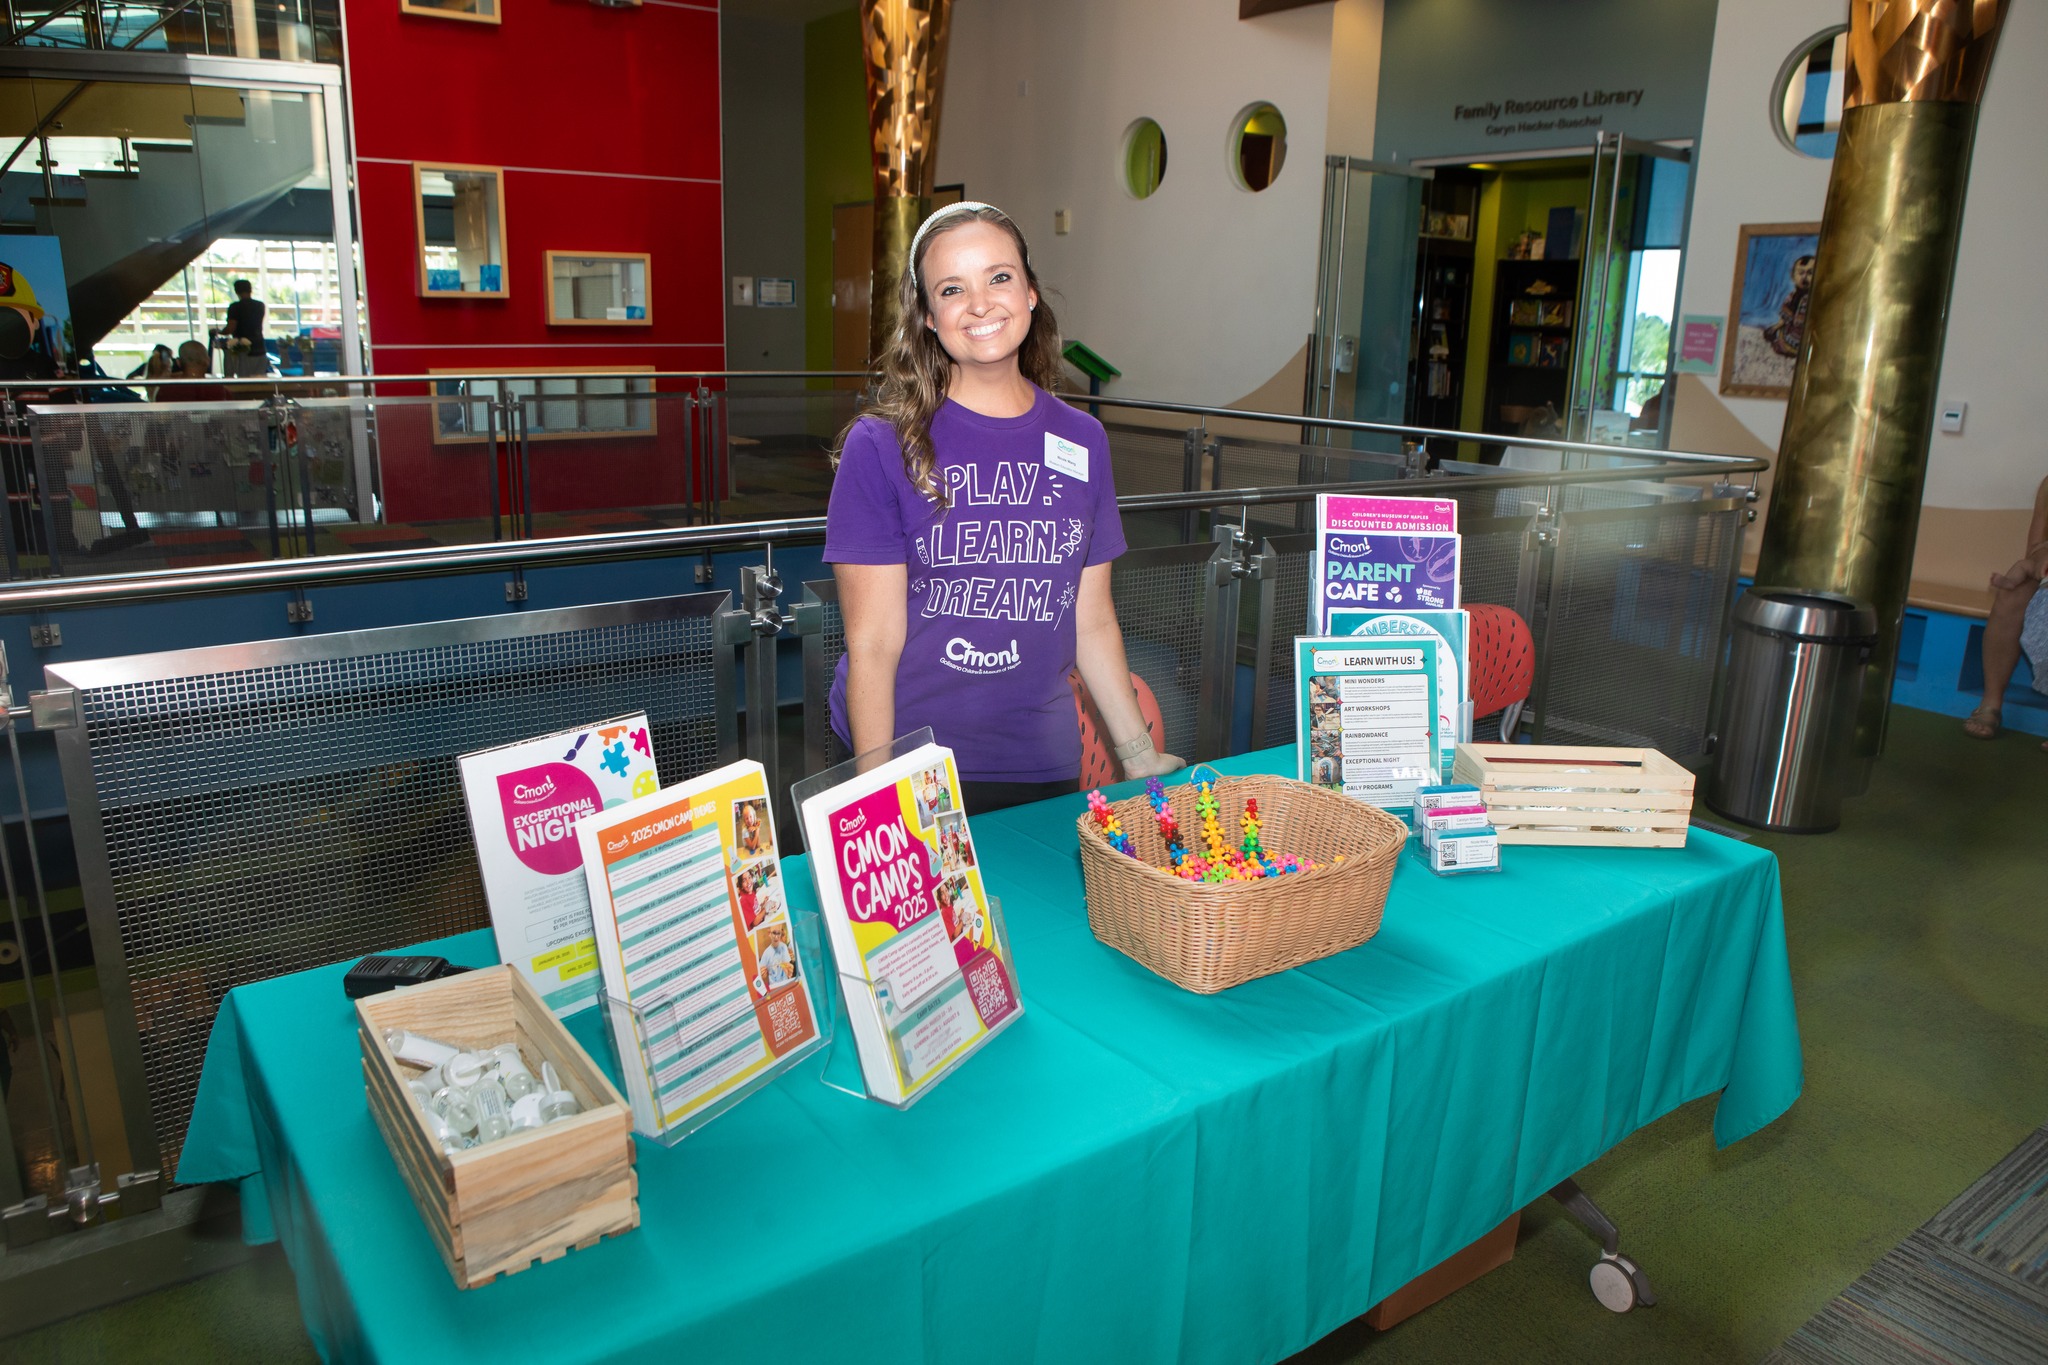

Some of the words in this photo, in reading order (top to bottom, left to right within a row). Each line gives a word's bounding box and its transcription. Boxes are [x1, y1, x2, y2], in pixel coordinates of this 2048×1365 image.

[1455, 102, 1501, 120] Family
[1504, 96, 1579, 114] Resource
[1583, 89, 1644, 107] Library
[1486, 123, 1516, 136] Caryn
[944, 462, 1052, 508] PLAY.
[1332, 520, 1393, 529] DISCOUNTED
[1396, 522, 1448, 531] ADMISSION
[931, 520, 1062, 568] LEARN.
[1328, 561, 1416, 582] PARENT
[921, 577, 1054, 621] DREAM.
[1326, 582, 1378, 602] CAFE
[1417, 594, 1444, 604] STRONG
[1344, 657, 1373, 666] LEARN
[1375, 656, 1398, 666] WITH
[1400, 656, 1416, 665] US!
[513, 797, 594, 829] EXCEPTIONAL
[631, 825, 653, 844] 2025
[652, 817, 675, 835] CMON
[674, 808, 694, 826] CAMP
[843, 814, 909, 879] CMON
[852, 852, 923, 920] CAMPS
[553, 915, 568, 924] EVENT
[894, 890, 928, 928] 2025
[568, 916, 587, 926] PERSON
[546, 934, 574, 948] UPCOMING
[928, 998, 941, 1011] DATES
